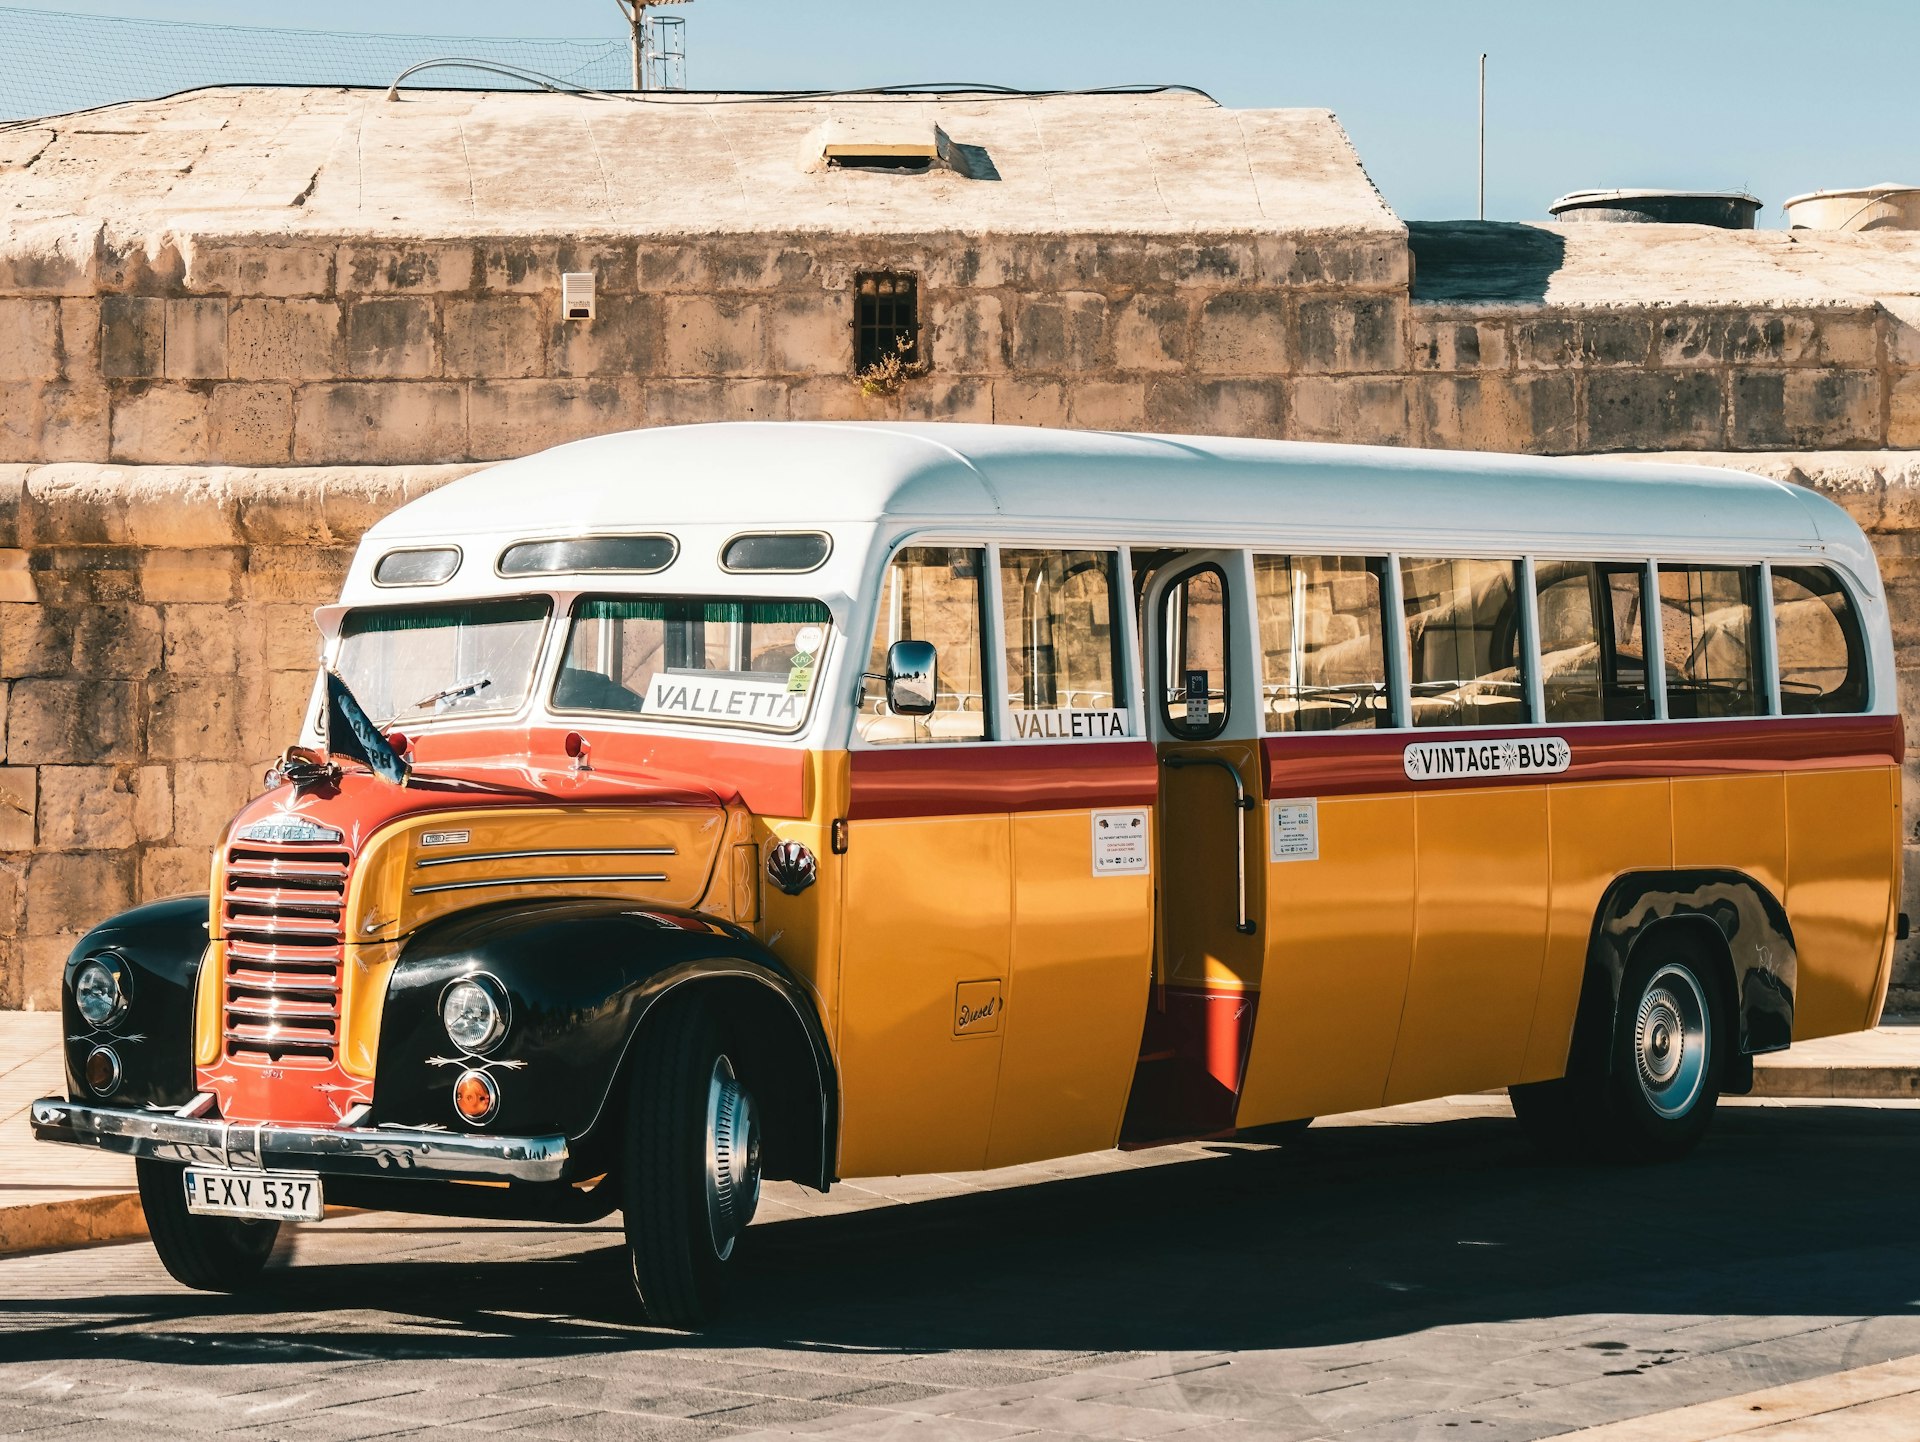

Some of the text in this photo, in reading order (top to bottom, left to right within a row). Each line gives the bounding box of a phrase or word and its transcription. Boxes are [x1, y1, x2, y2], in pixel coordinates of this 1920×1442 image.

[656, 684, 796, 719] VALLETTA
[1014, 712, 1124, 738] VALLETTA
[1419, 743, 1558, 774] VINTAGE BUS
[252, 826, 314, 840] THAMES
[958, 996, 995, 1027] Diesel
[203, 1177, 312, 1211] EXY 537
